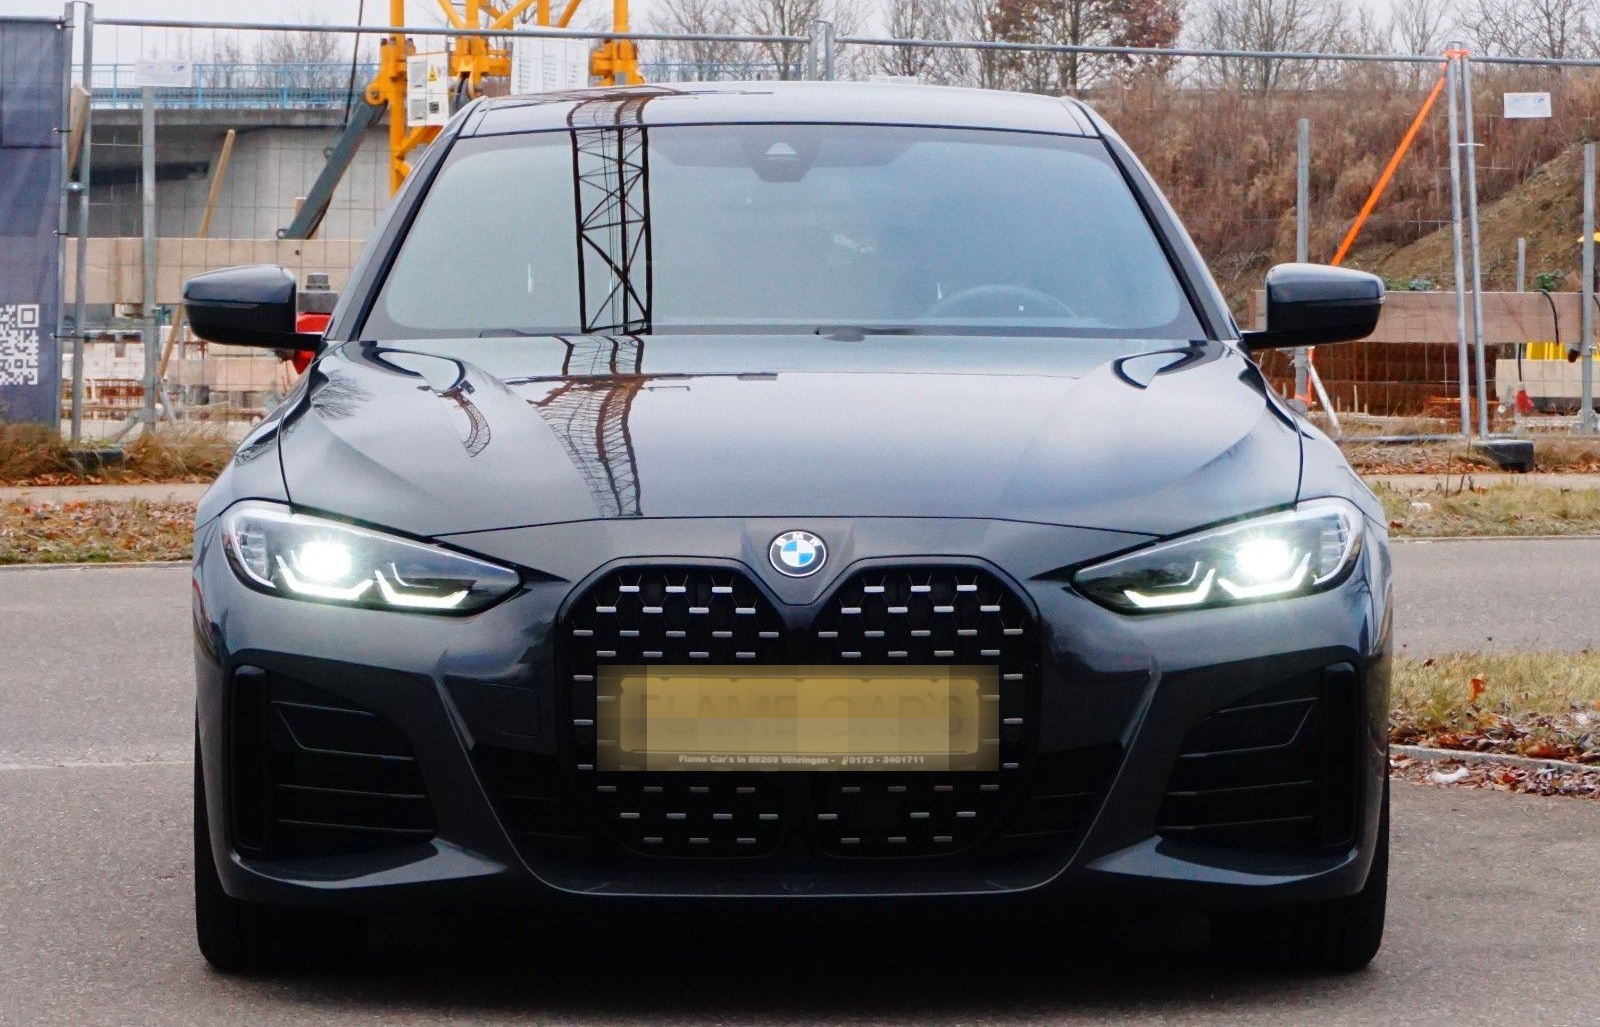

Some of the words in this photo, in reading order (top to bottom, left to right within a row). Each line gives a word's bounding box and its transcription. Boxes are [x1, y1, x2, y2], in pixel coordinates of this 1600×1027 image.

[640, 695, 797, 735] FLAME
[678, 754, 708, 763] Flame
[736, 755, 746, 763] in
[748, 755, 779, 764] 89269
[781, 755, 829, 766] Vöhringen
[849, 756, 874, 764] 0173
[882, 755, 924, 764] 3401711
